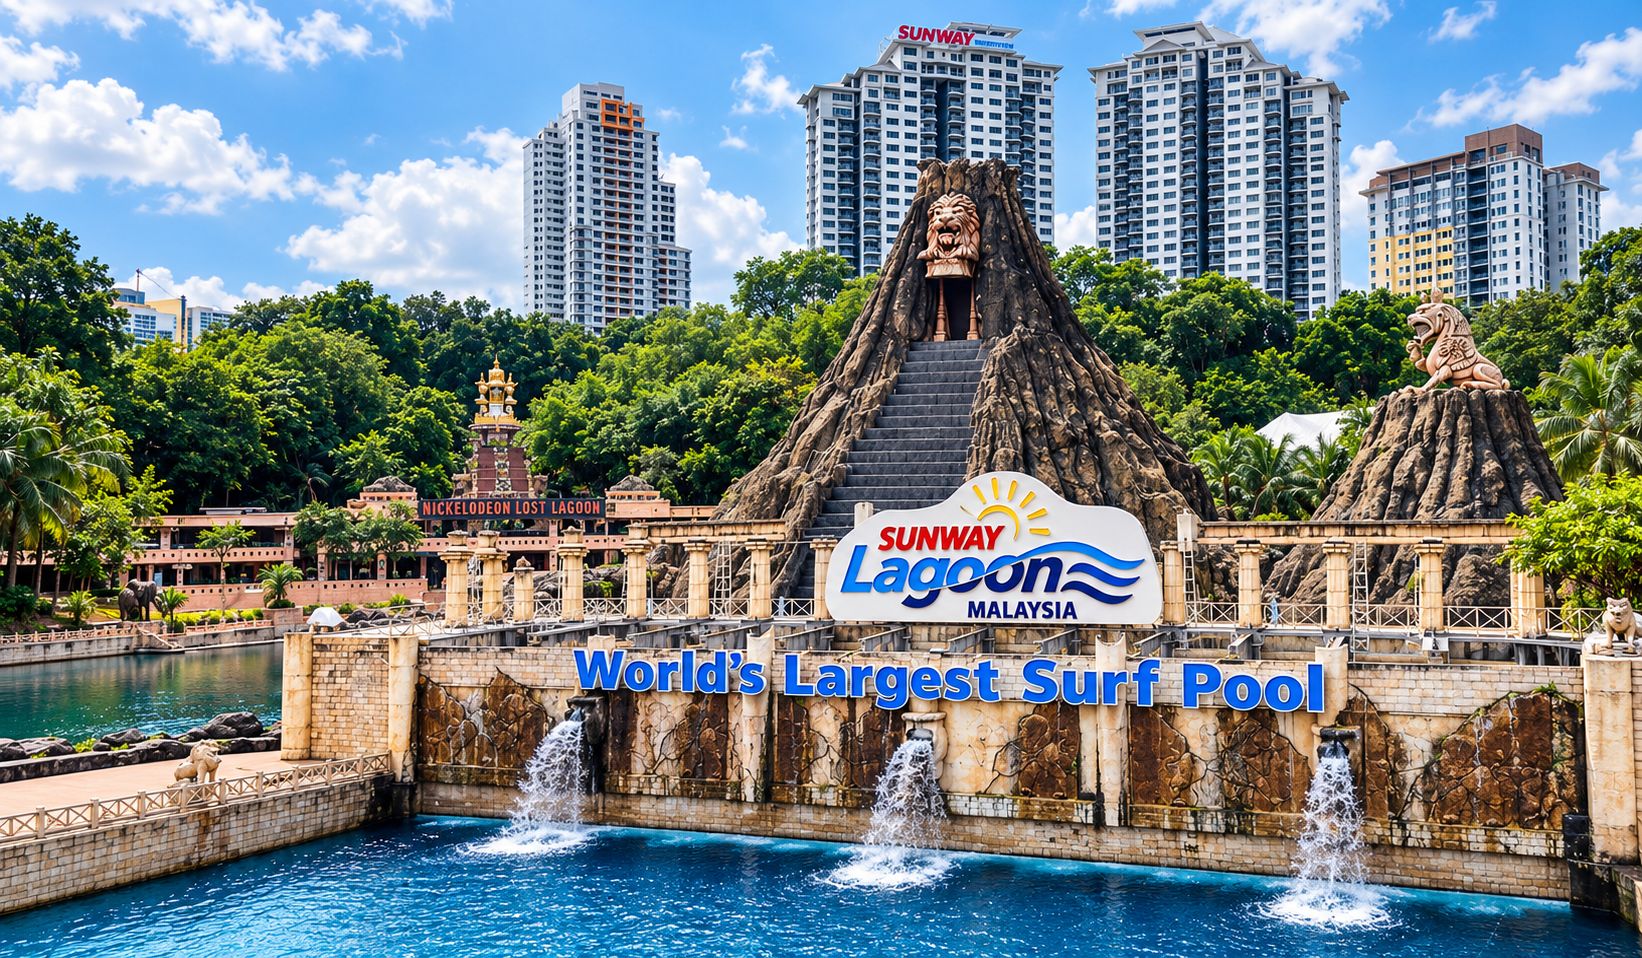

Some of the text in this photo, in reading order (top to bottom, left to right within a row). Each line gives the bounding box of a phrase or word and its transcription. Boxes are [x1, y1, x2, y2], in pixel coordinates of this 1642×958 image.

[898, 25, 975, 46] SUNWAY
[422, 500, 600, 516] NICKELODEON LOST LAGOON
[878, 526, 1005, 550] SUNWAY
[840, 545, 1064, 609] Lagoon
[967, 601, 1078, 620] MALAYSIA
[573, 649, 1325, 714] World’s Largest Surf Pool
